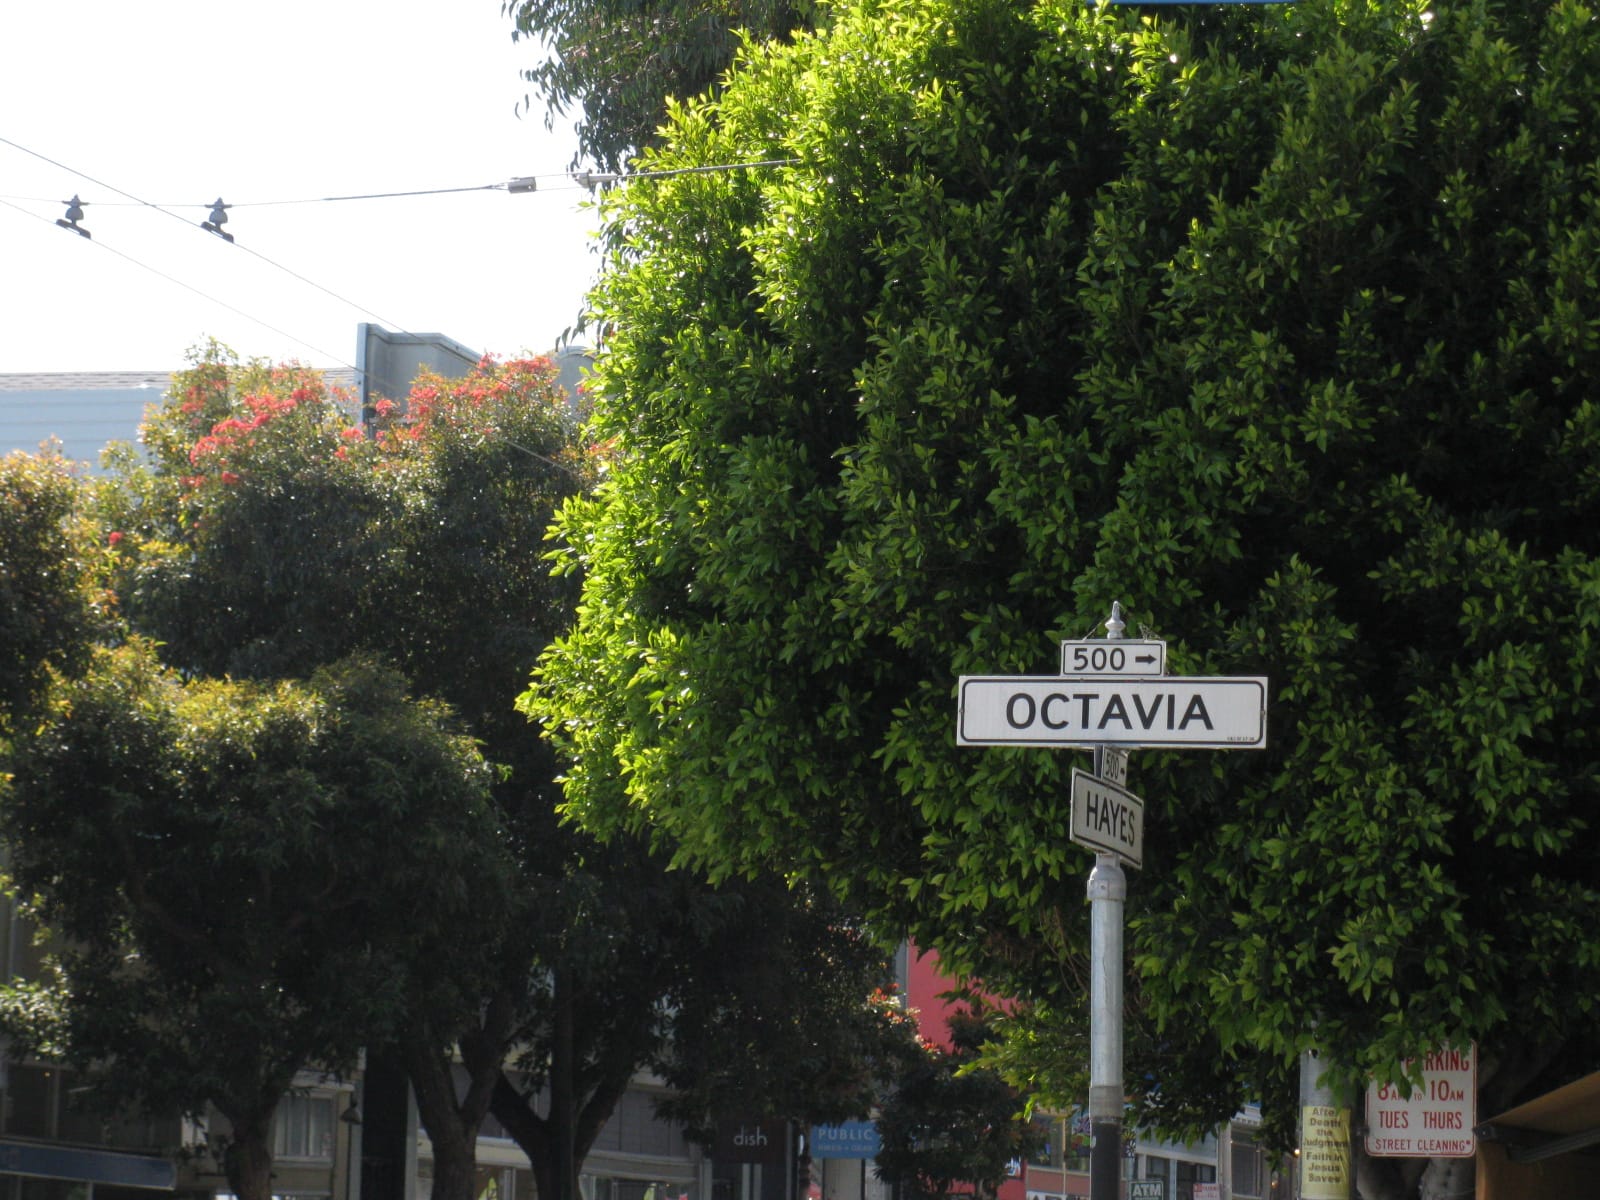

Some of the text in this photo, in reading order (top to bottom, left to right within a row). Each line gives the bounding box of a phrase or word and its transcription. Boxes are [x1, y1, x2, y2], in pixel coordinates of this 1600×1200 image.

[1073, 647, 1126, 671] 500
[1005, 692, 1214, 731] OCTAVIA
[1105, 751, 1120, 779] 500
[1086, 790, 1135, 848] HAYES
[1312, 1107, 1336, 1116] Afte
[1310, 1117, 1342, 1128] Death
[1378, 1110, 1463, 1130] TUES THURS
[733, 1126, 768, 1147] dish
[817, 1128, 873, 1141] PUBLIC
[1375, 1138, 1466, 1152] STREET CLEANING
[1306, 1151, 1332, 1161] Faith
[1309, 1162, 1341, 1172] Jesus
[1309, 1173, 1341, 1183] Saves
[1132, 1183, 1162, 1197] ATM
